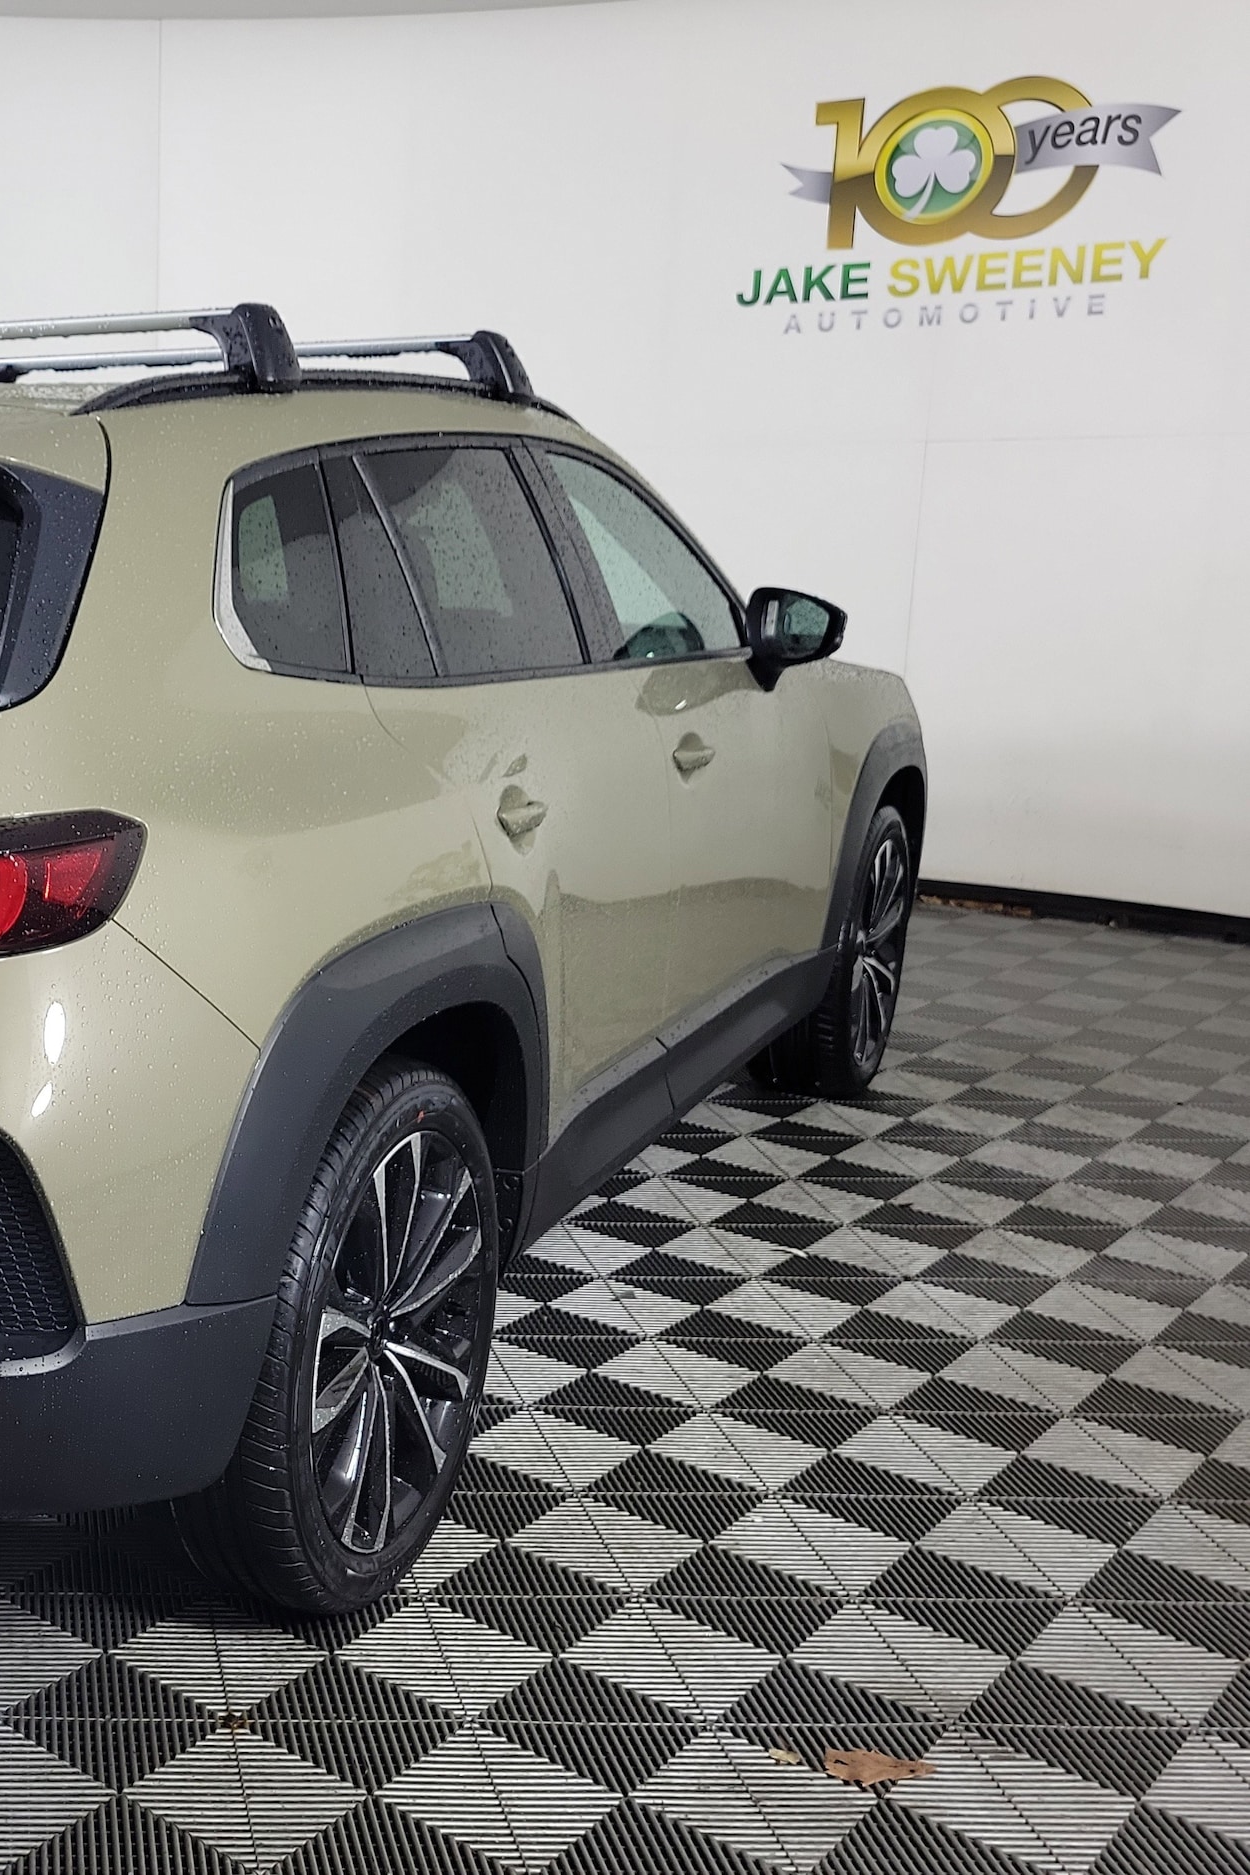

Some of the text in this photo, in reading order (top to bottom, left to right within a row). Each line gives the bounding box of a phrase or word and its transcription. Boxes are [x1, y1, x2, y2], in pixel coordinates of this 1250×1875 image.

[815, 75, 1144, 251] 100 years
[736, 237, 1168, 308] JAKE SWEENEY
[782, 293, 1106, 335] AUTOMOTIVE
